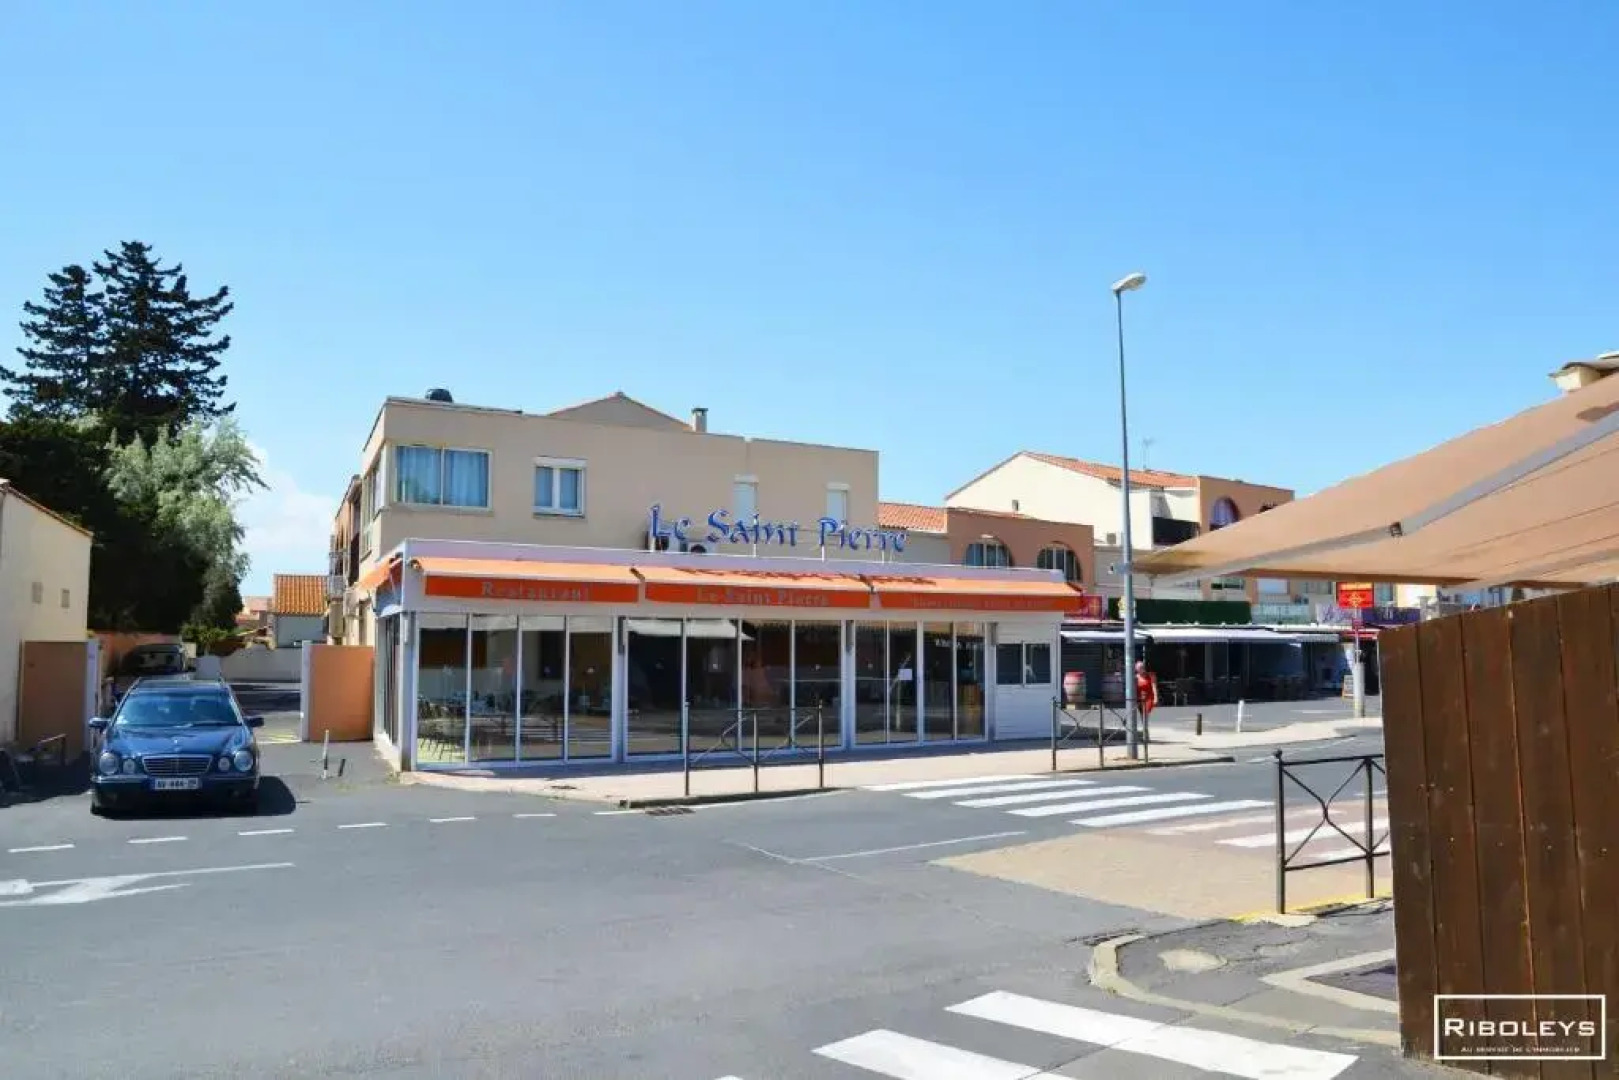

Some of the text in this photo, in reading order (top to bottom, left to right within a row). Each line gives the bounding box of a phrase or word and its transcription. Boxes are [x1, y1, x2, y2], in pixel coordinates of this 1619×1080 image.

[650, 503, 910, 552] Le Saint Pierre
[481, 581, 591, 602] Restaurant
[697, 586, 829, 607] Le Saint Pierre
